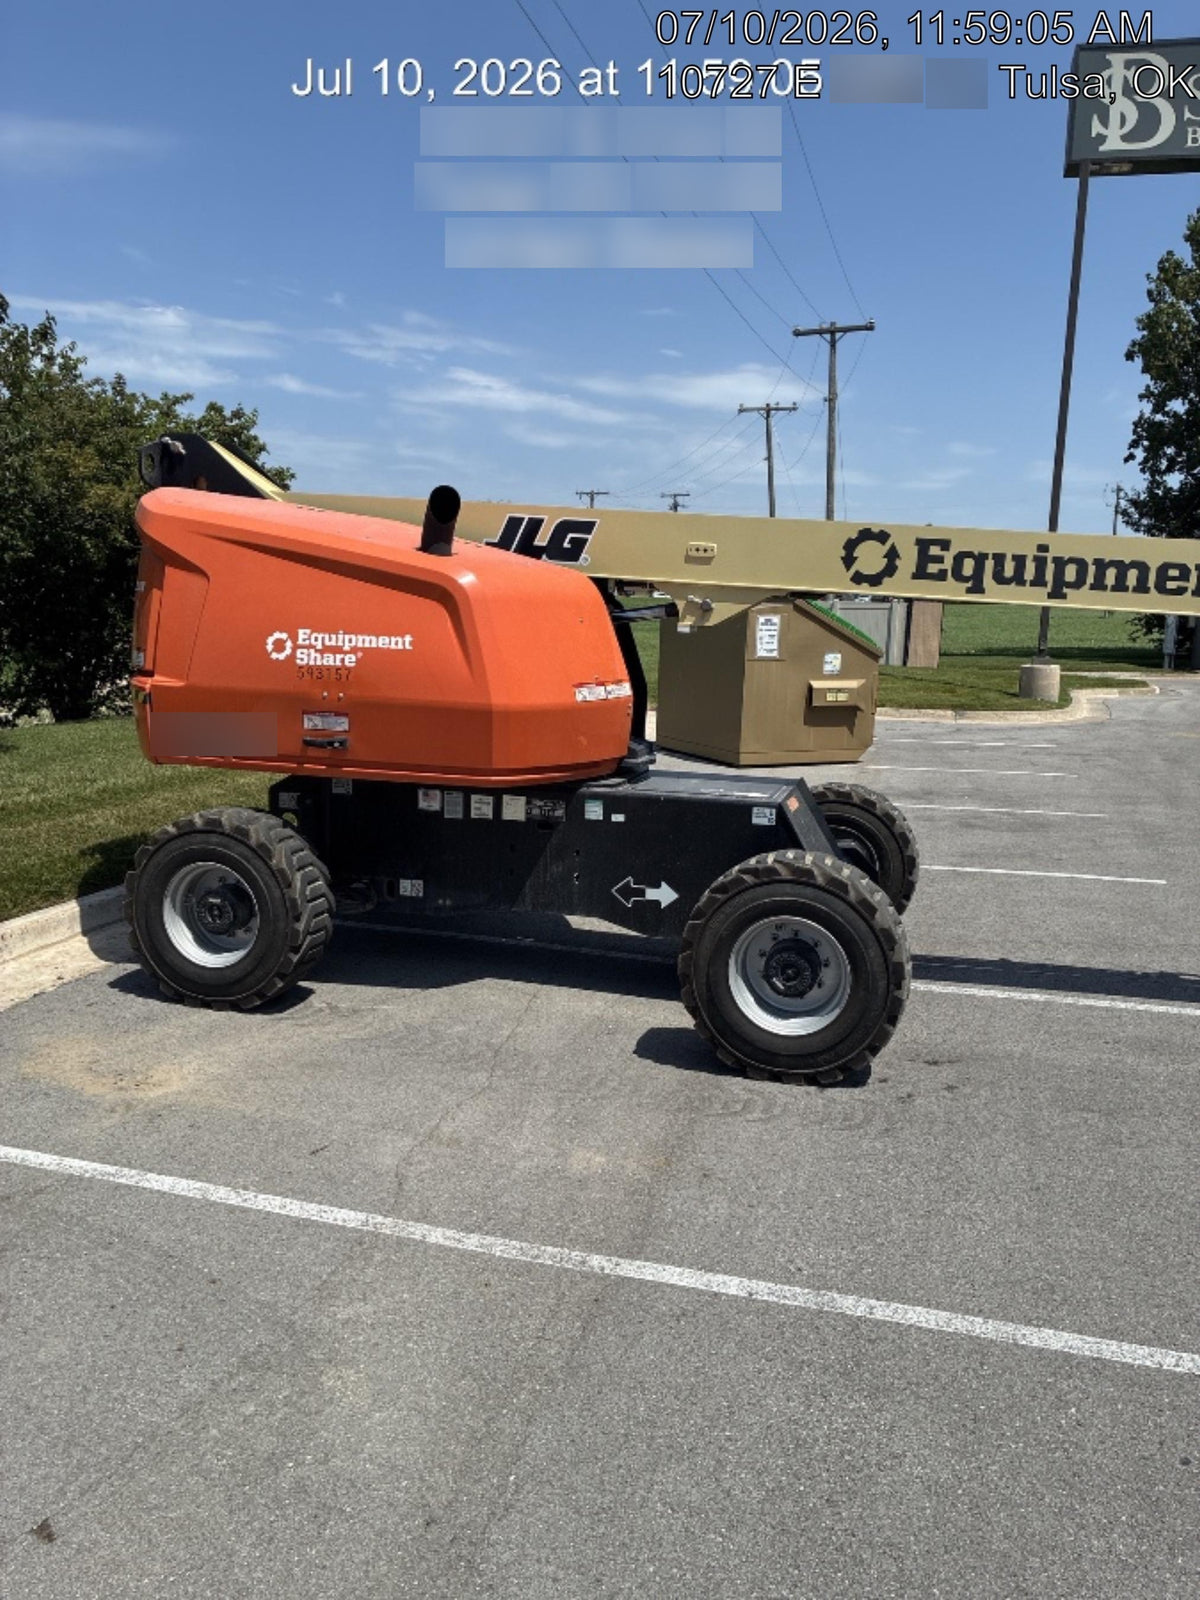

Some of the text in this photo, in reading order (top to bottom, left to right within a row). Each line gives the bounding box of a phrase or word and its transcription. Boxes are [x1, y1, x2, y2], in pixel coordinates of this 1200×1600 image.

[483, 514, 600, 565] JLG
[911, 537, 1200, 600] Equipme
[296, 649, 357, 667] Share
[297, 629, 413, 651] Equipment
